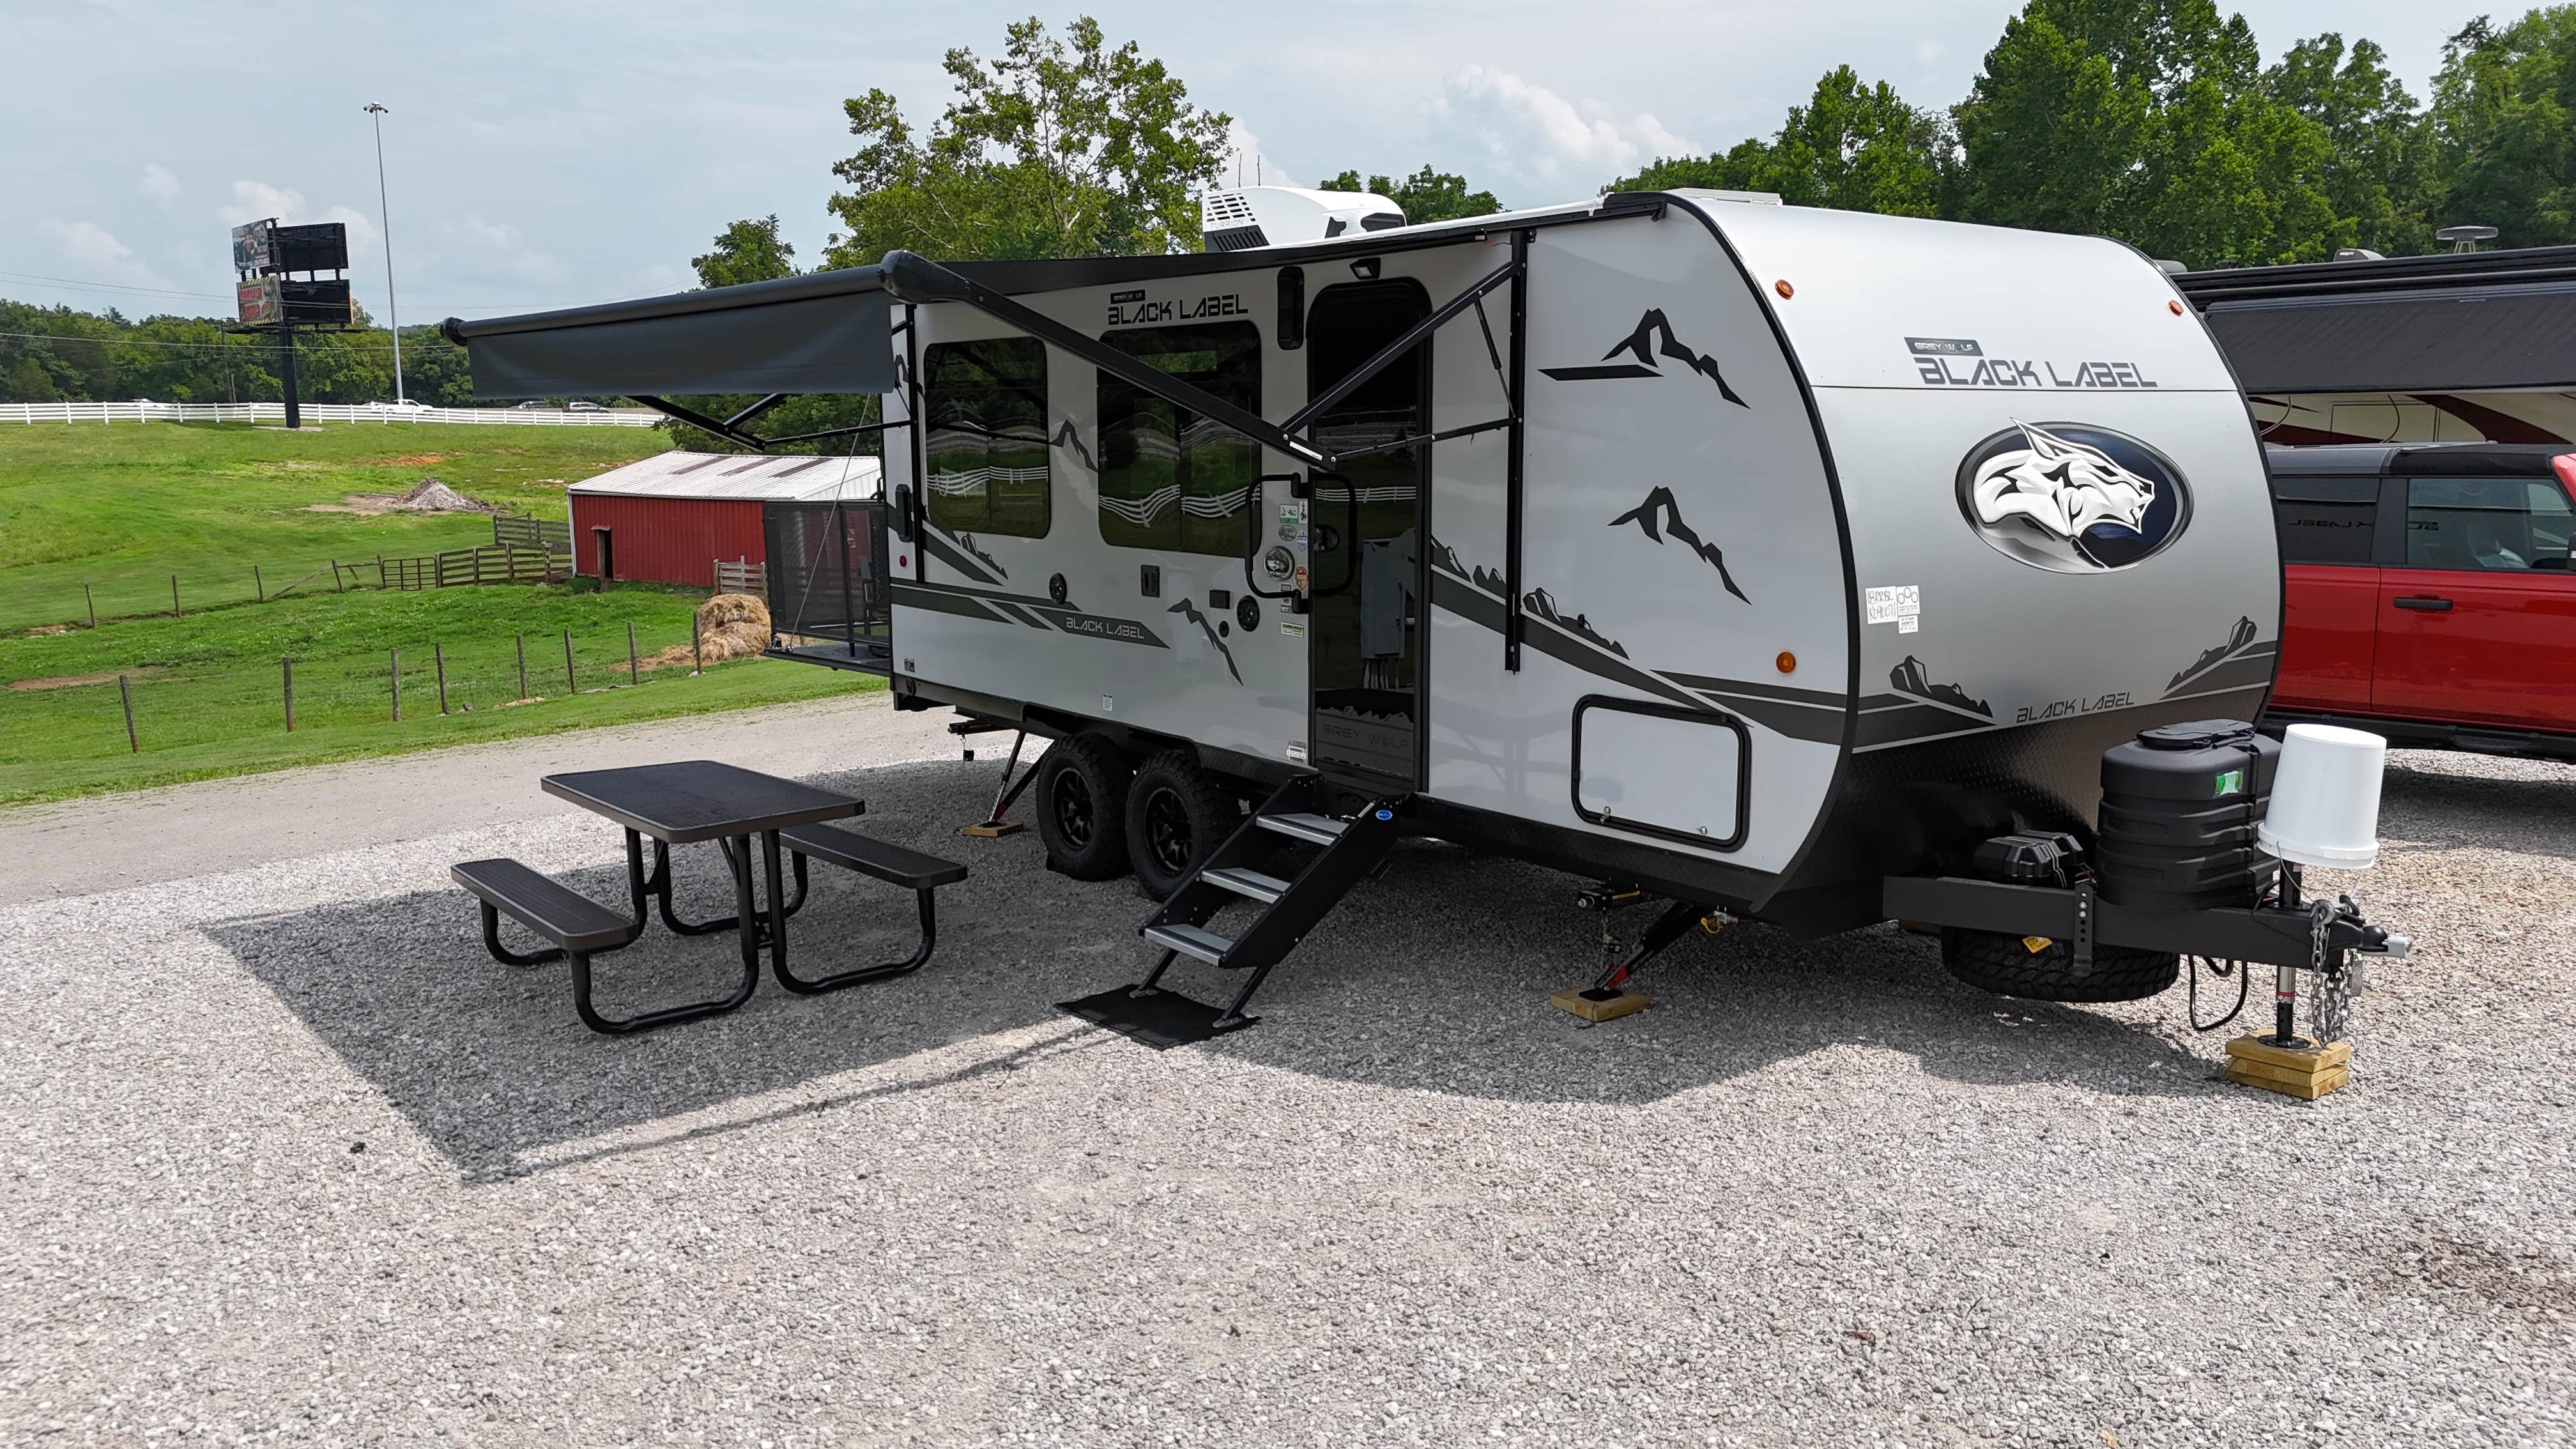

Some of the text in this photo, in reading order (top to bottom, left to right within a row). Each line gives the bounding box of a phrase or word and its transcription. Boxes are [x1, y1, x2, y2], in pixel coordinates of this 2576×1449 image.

[1107, 294, 1248, 325] BLACK LABEL
[1913, 342, 1942, 351] GREY
[1913, 357, 2159, 388] BLACK LABEL
[1066, 617, 1144, 639] BLACK LABEL
[2016, 691, 2135, 723] BLACK LABEL
[1322, 723, 1361, 739] GREY
